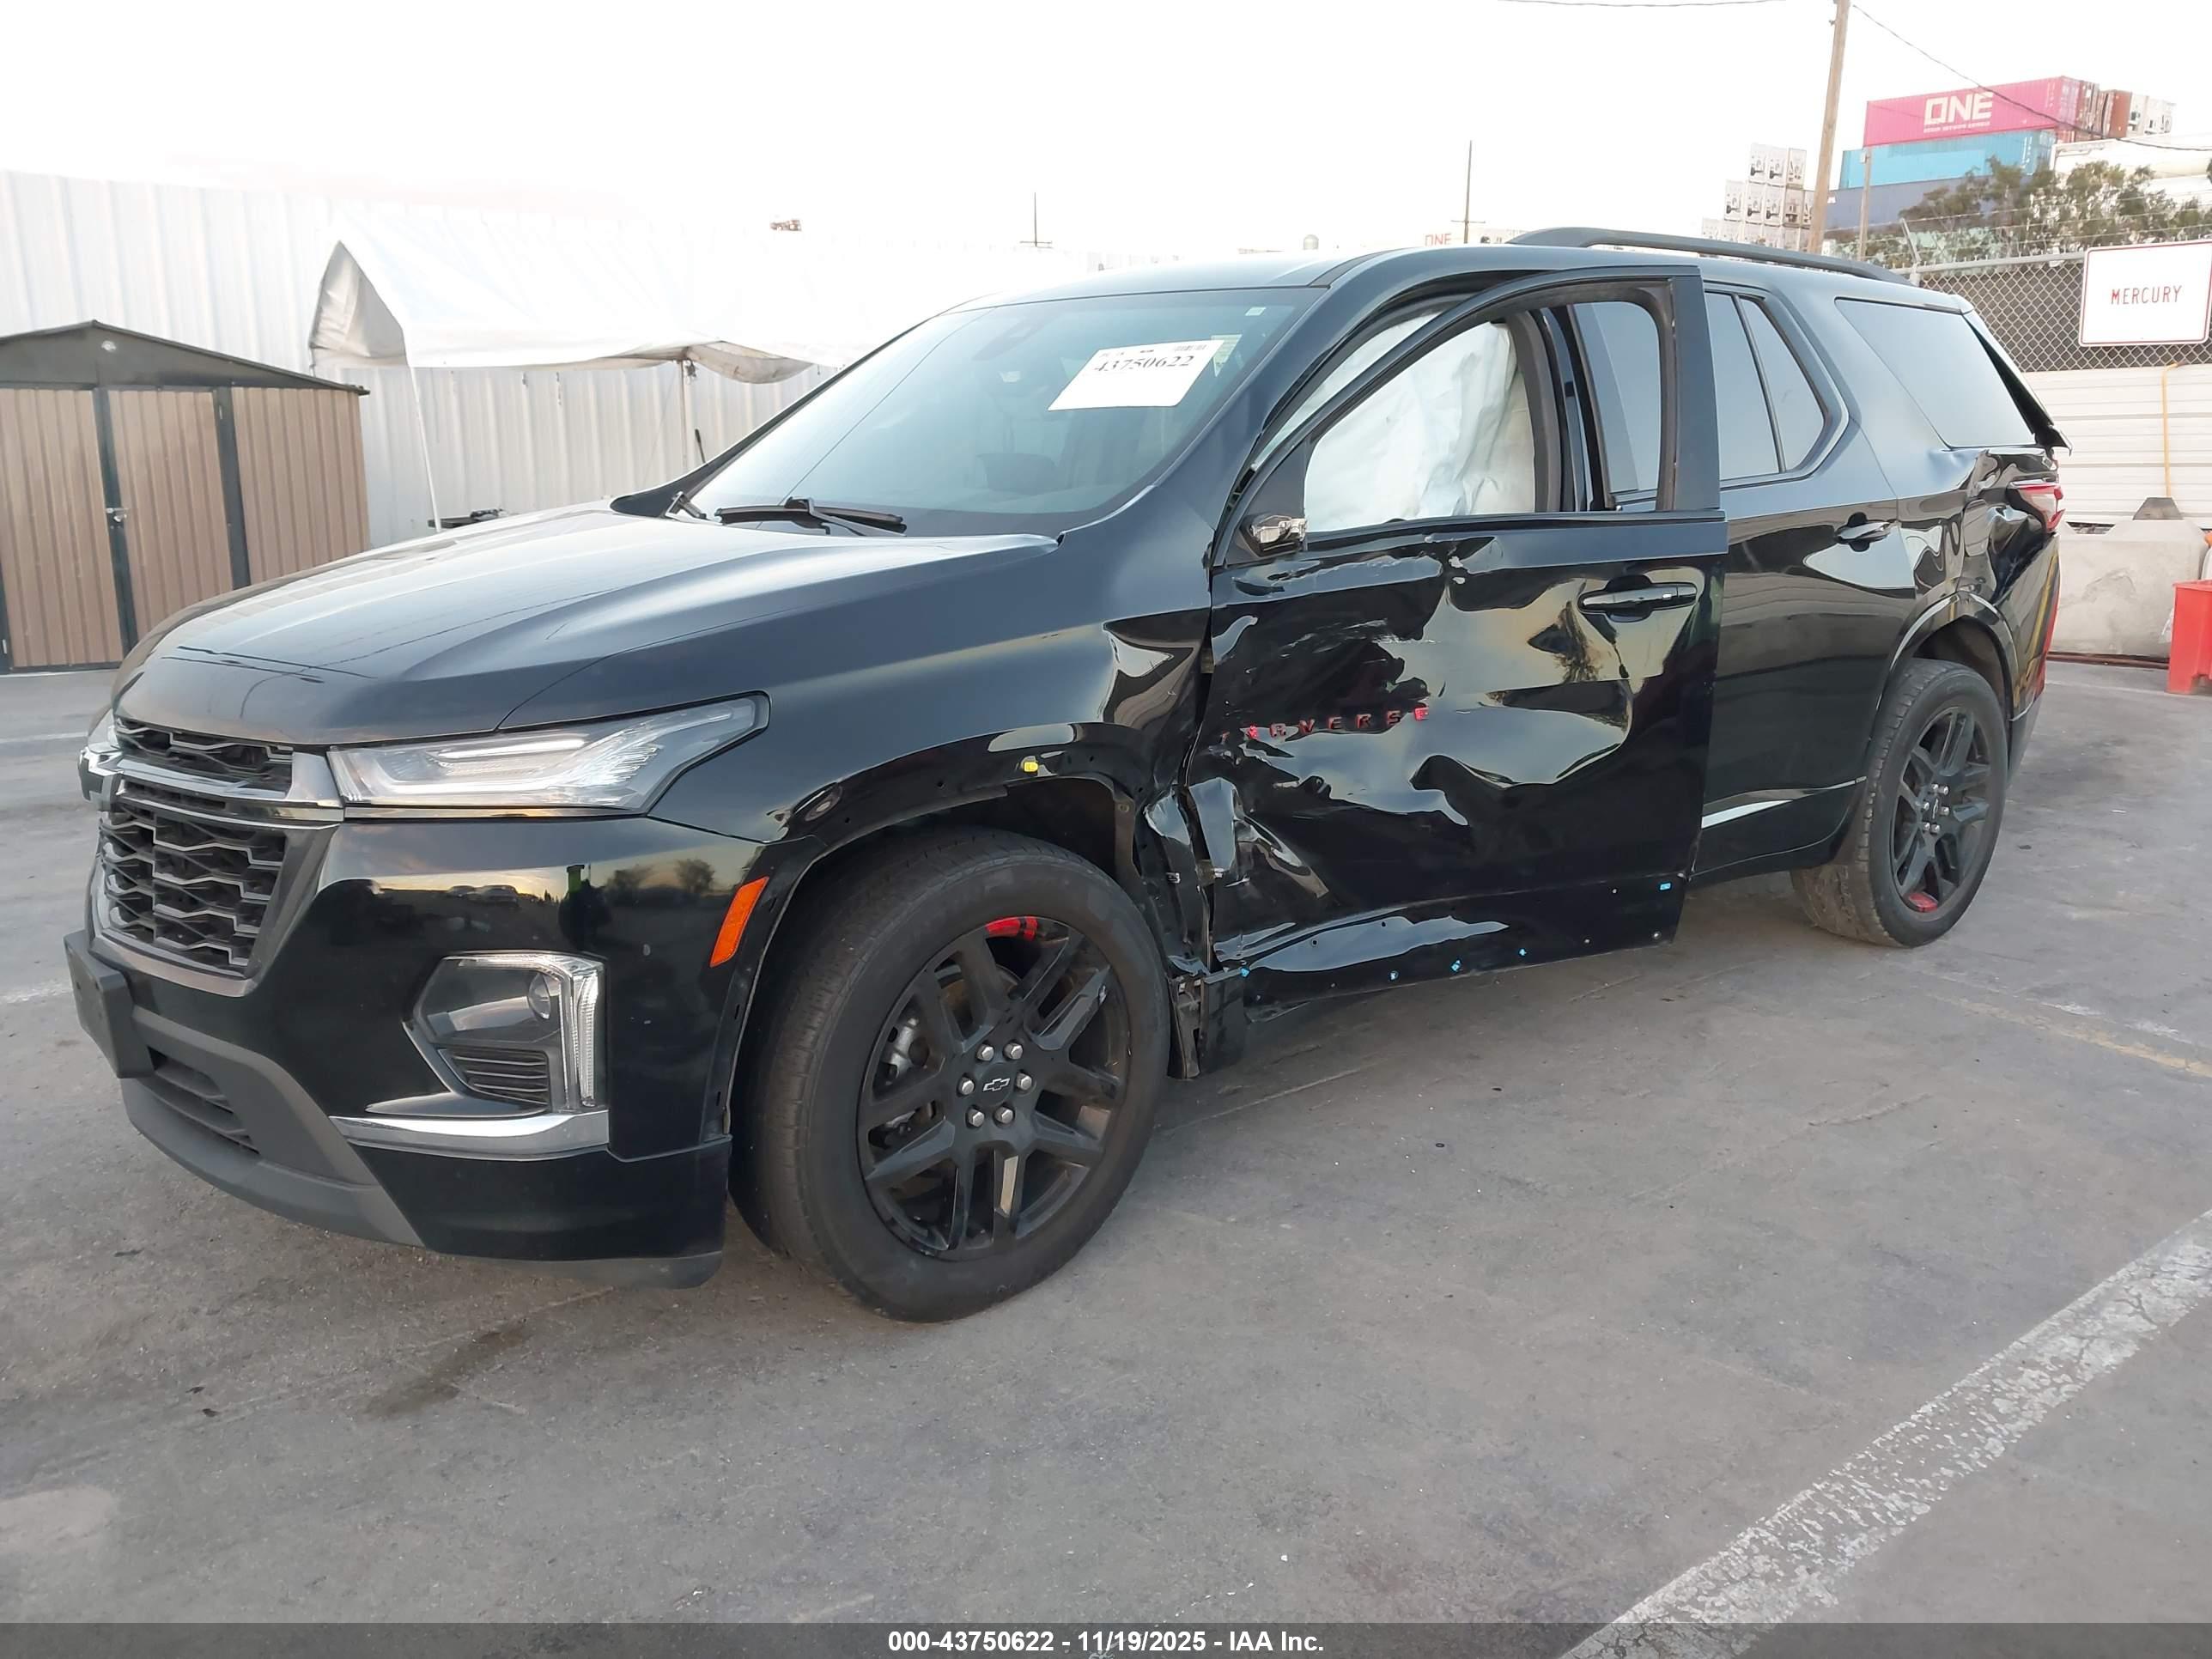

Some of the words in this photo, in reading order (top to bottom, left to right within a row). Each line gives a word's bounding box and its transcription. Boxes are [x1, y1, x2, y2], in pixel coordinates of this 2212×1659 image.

[1923, 91, 1994, 125] ONE
[2111, 285, 2182, 305] MERCURY
[1094, 355, 1195, 372] 43750622
